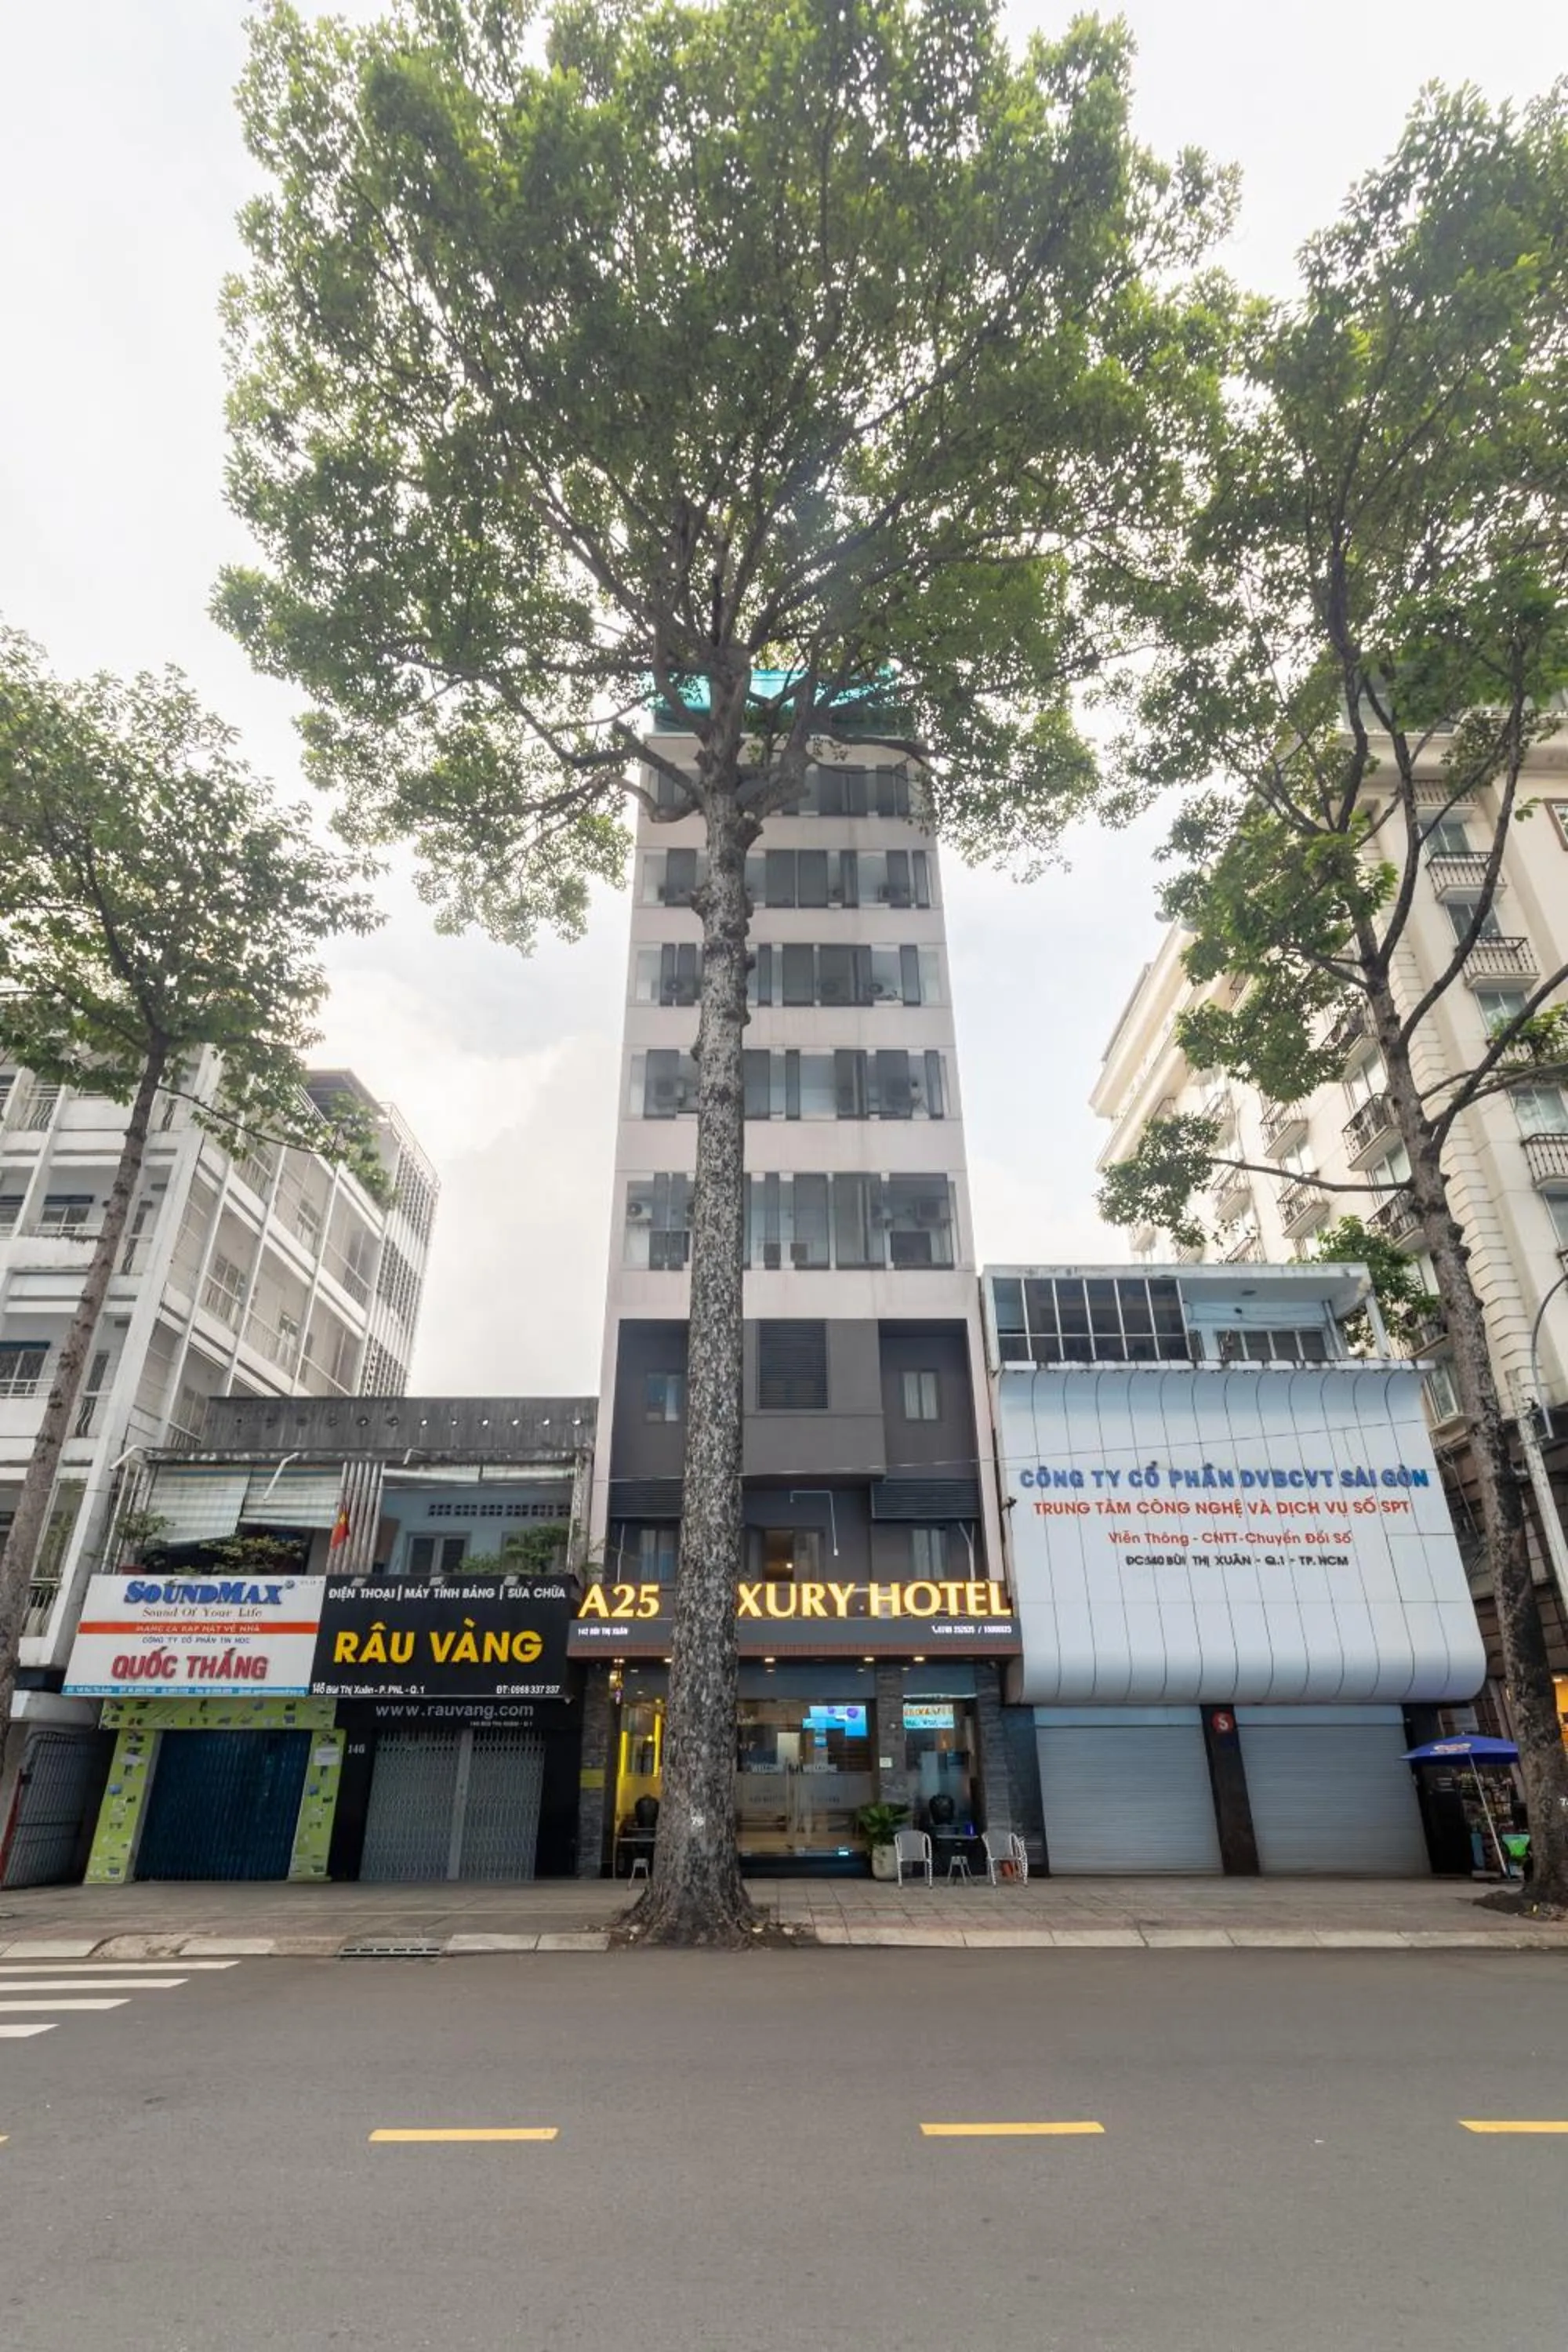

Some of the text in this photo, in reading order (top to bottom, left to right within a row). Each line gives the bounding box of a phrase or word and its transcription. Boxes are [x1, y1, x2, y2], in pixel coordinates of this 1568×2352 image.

[1020, 1465, 1084, 1487] CÔNG
[1091, 1469, 1120, 1487] TY
[1128, 1461, 1160, 1487] CỔ
[1240, 1468, 1334, 1487] DVBCVT
[1340, 1465, 1377, 1487] SÀI
[1381, 1464, 1429, 1487] GÒN
[1033, 1496, 1410, 1518] TRUNG TÂM CÔNG NGHỆ VÀ DỊCH VỤ SỐ SPT
[1144, 1531, 1189, 1547] Thông
[328, 1586, 355, 1602] ĐIỆN
[360, 1588, 395, 1601] THOẠI
[404, 1584, 430, 1599] MÁY
[434, 1584, 460, 1599] TÍNH
[578, 1581, 1011, 1617] A25 XURY HOTEL
[142, 1607, 178, 1617] Sound
[202, 1608, 233, 1618] Your
[238, 1608, 263, 1618] Life
[333, 1617, 543, 1663] RÂU VÀNG
[111, 1646, 178, 1680] QUỐC
[375, 1704, 535, 1719] www.rauvang.com
